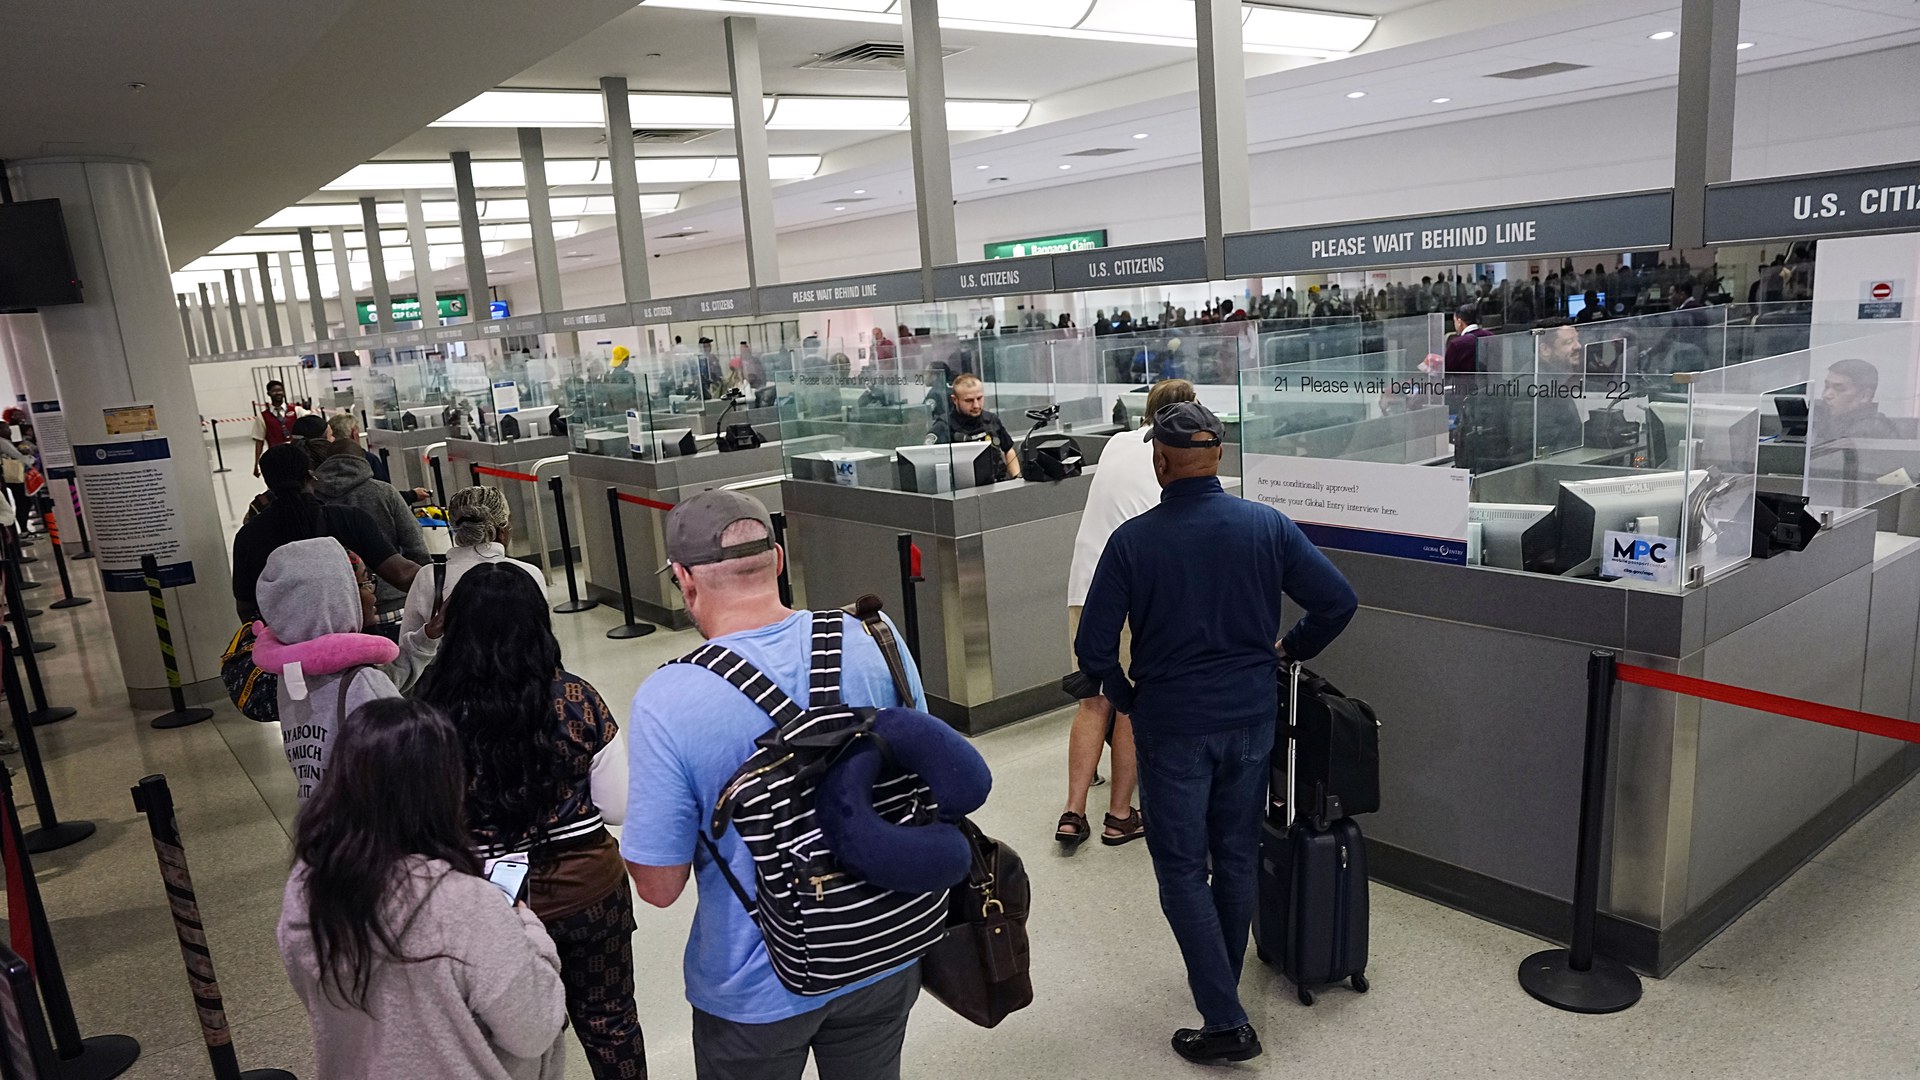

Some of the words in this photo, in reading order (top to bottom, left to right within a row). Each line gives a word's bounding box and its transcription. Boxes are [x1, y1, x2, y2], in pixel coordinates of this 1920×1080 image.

[1793, 193, 1845, 219] U.S.
[1070, 239, 1095, 251] Claim
[1311, 236, 1365, 258] PLEASE
[1373, 232, 1414, 253] WAIT
[1421, 225, 1487, 249] BEHIND
[1496, 221, 1536, 244] LINE
[1089, 261, 1111, 278] U.S.
[1114, 256, 1165, 274] CITIZENS
[960, 274, 978, 288] U.S.
[980, 270, 1020, 286] CITIZENS
[792, 290, 815, 303] PLEASE
[816, 288, 832, 300] WAIT
[834, 286, 859, 299] BEHIND
[861, 284, 877, 297] LINE
[712, 299, 734, 311] CITIZENS
[914, 374, 924, 386] 20
[1274, 376, 1288, 392] 21
[1301, 376, 1349, 394] Please
[1354, 378, 1385, 394] wait
[1391, 378, 1444, 396] behind
[1486, 380, 1520, 397] until
[1527, 379, 1587, 399] called.
[1606, 381, 1631, 400] 22
[837, 463, 854, 476] MPC
[1258, 477, 1268, 485] Are
[1282, 480, 1324, 492] conditionally
[1326, 485, 1359, 494] approved?
[1257, 493, 1286, 505] Complete
[1288, 498, 1303, 506] your
[1304, 498, 1325, 508] Global
[1327, 501, 1345, 512] Entry
[1347, 503, 1379, 513] interview
[1381, 506, 1399, 515] here.
[1613, 538, 1667, 564] MPC
[292, 724, 328, 742] ABOUT
[292, 744, 322, 762] MUCH
[298, 764, 328, 781] THIN
